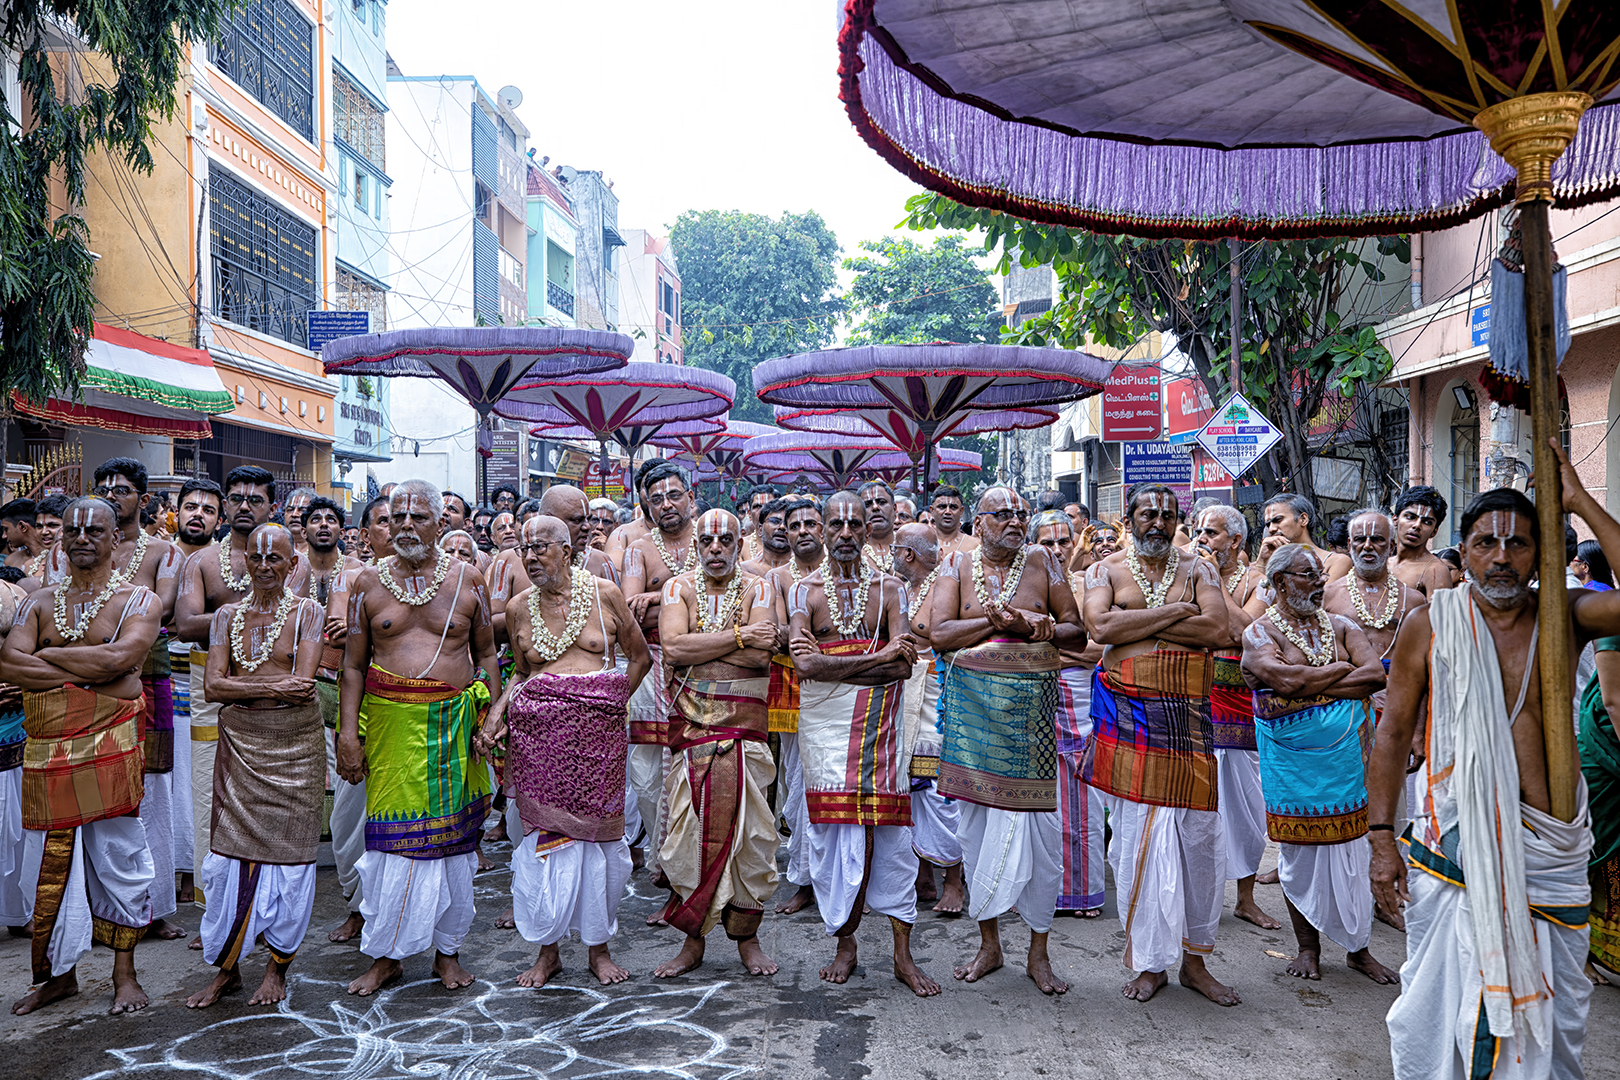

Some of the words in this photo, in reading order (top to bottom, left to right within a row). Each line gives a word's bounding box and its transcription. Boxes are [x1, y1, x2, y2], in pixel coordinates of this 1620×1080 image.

[1105, 376, 1149, 386] MedPlus
[1105, 409, 1134, 419] மருந்து
[1125, 444, 1136, 455] Dr.
[1137, 444, 1145, 455] N.
[1146, 443, 1195, 455] UDAYAKUMA
